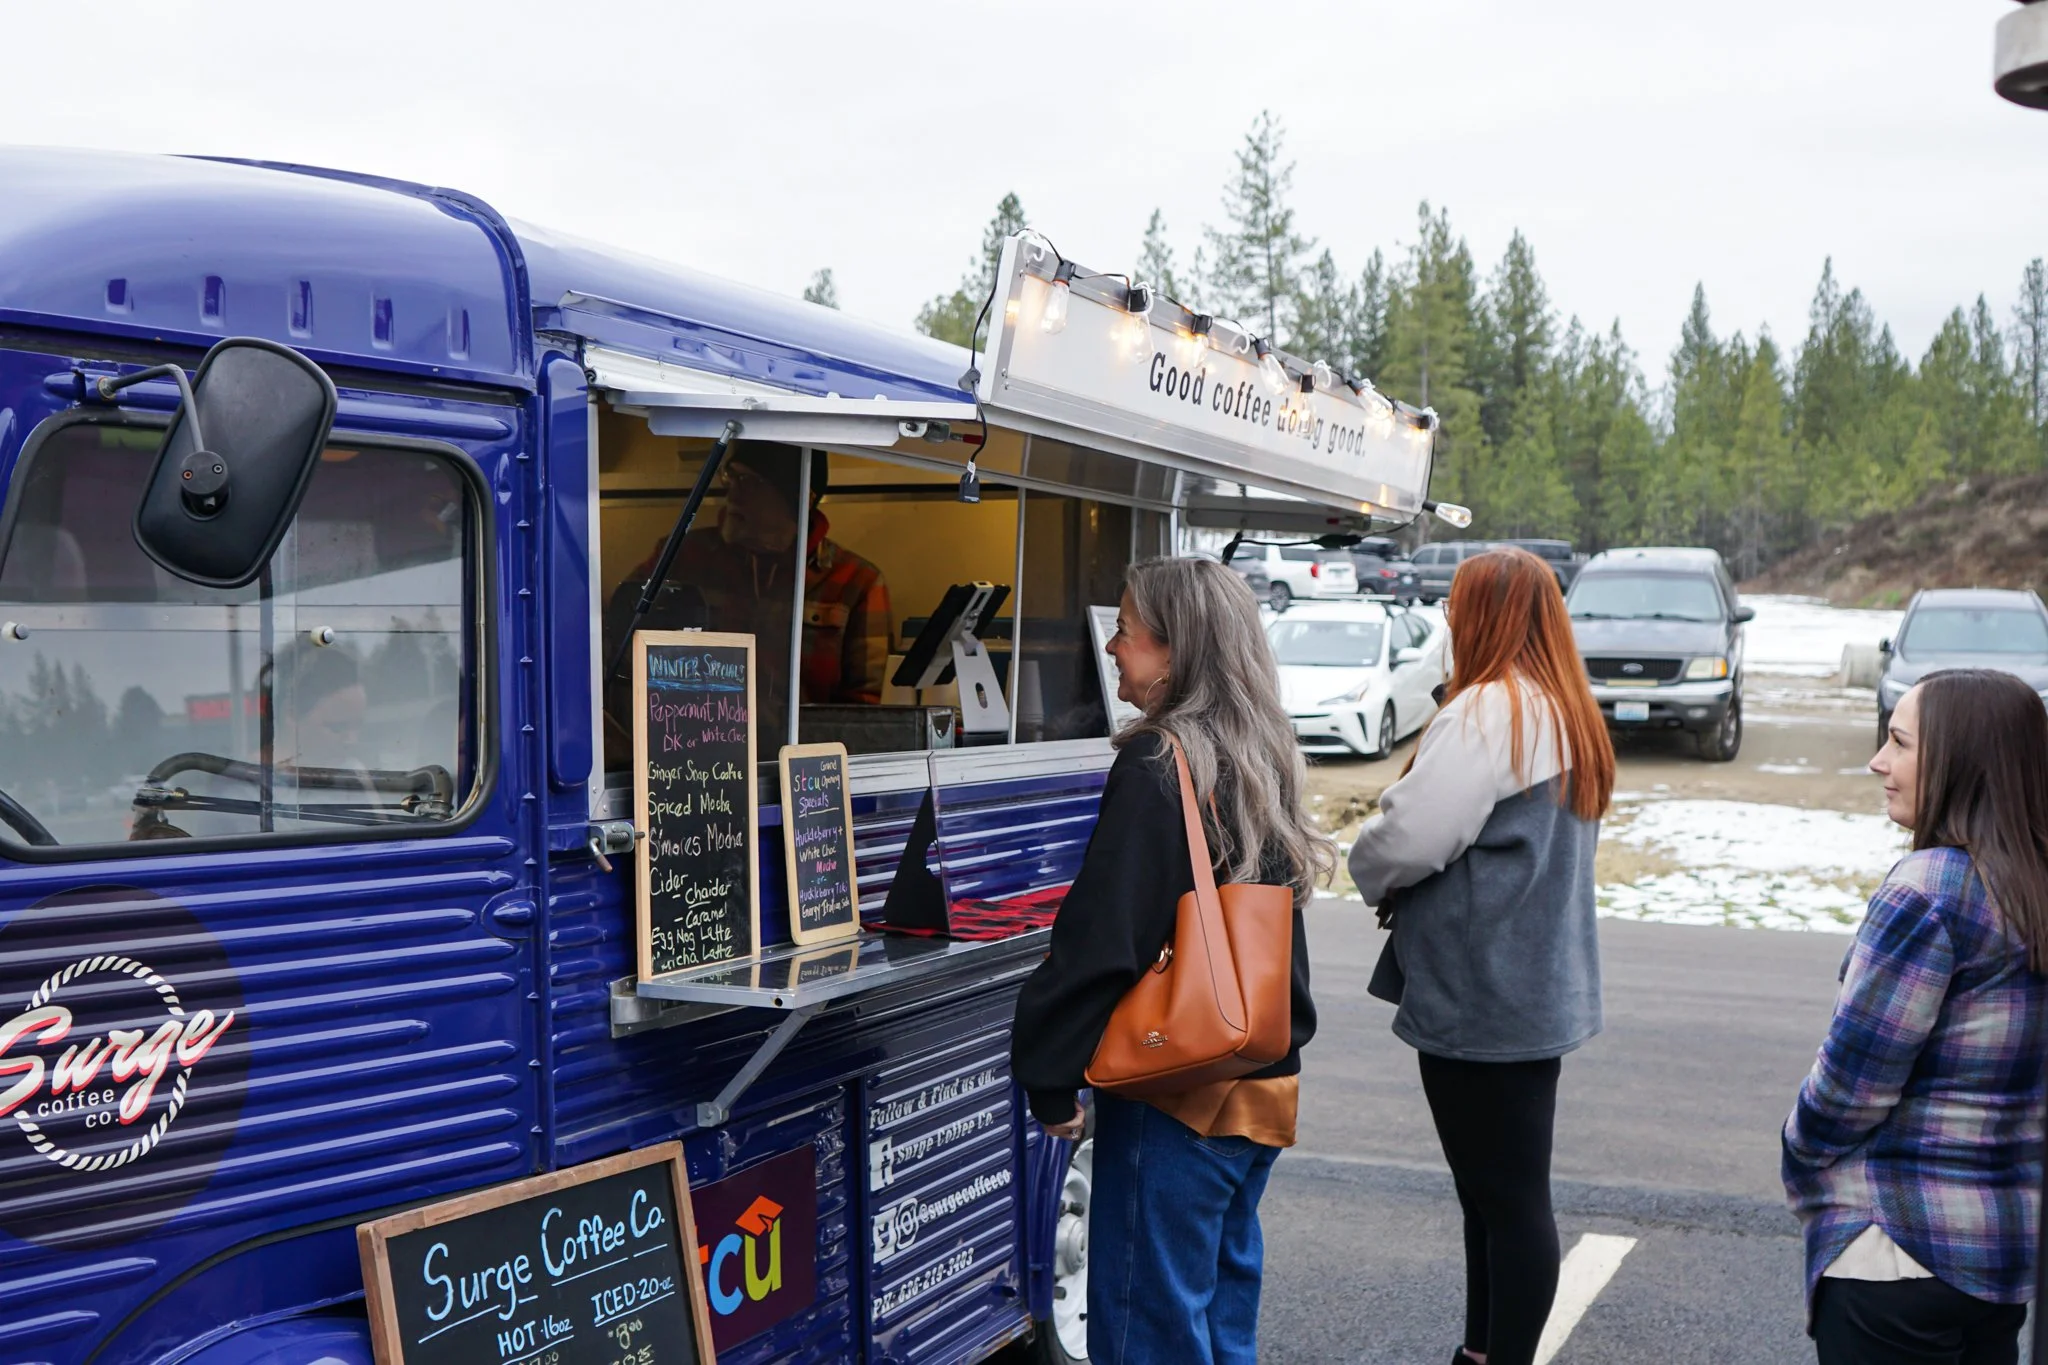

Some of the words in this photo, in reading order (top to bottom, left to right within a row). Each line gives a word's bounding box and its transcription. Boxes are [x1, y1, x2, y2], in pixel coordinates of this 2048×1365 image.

[1149, 351, 1207, 406] Good
[1212, 381, 1271, 427] coffee
[1327, 417, 1366, 458] good.
[649, 653, 701, 679] WINTER
[650, 692, 716, 734] Peppermint
[717, 693, 750, 724] Mocha
[663, 733, 683, 753] DK
[686, 738, 699, 748] or
[648, 761, 682, 790] Ginger
[685, 759, 709, 789] Snap
[712, 761, 743, 780] Cookie
[648, 791, 692, 825] Spiced
[700, 788, 733, 815] Mocha
[649, 826, 701, 862] S'mores
[706, 822, 743, 852] Mocha
[795, 826, 838, 847] Huckleberry
[799, 846, 820, 863] White
[821, 843, 837, 857] Choc
[649, 866, 689, 896] Cider
[686, 902, 727, 928] Caramel
[651, 926, 674, 950] Egg
[676, 928, 696, 951] Nog
[700, 923, 734, 941] Latte
[702, 943, 735, 961] Latte
[0, 1006, 235, 1126] Surge
[37, 1088, 115, 1118] coffee
[869, 1098, 915, 1130] Follow
[917, 1090, 927, 1110] &
[930, 1077, 960, 1106] Find
[961, 1076, 976, 1093] us
[85, 1111, 119, 1129] co.
[895, 1136, 934, 1165] Surge
[936, 1119, 975, 1147] Coffee
[977, 1111, 994, 1130] Co.
[918, 1168, 1012, 1224] @surgecoffeeco
[423, 1243, 532, 1321] Surge
[541, 1207, 626, 1277] Coffee
[630, 1189, 666, 1238] Co.
[497, 1320, 536, 1358] HOT
